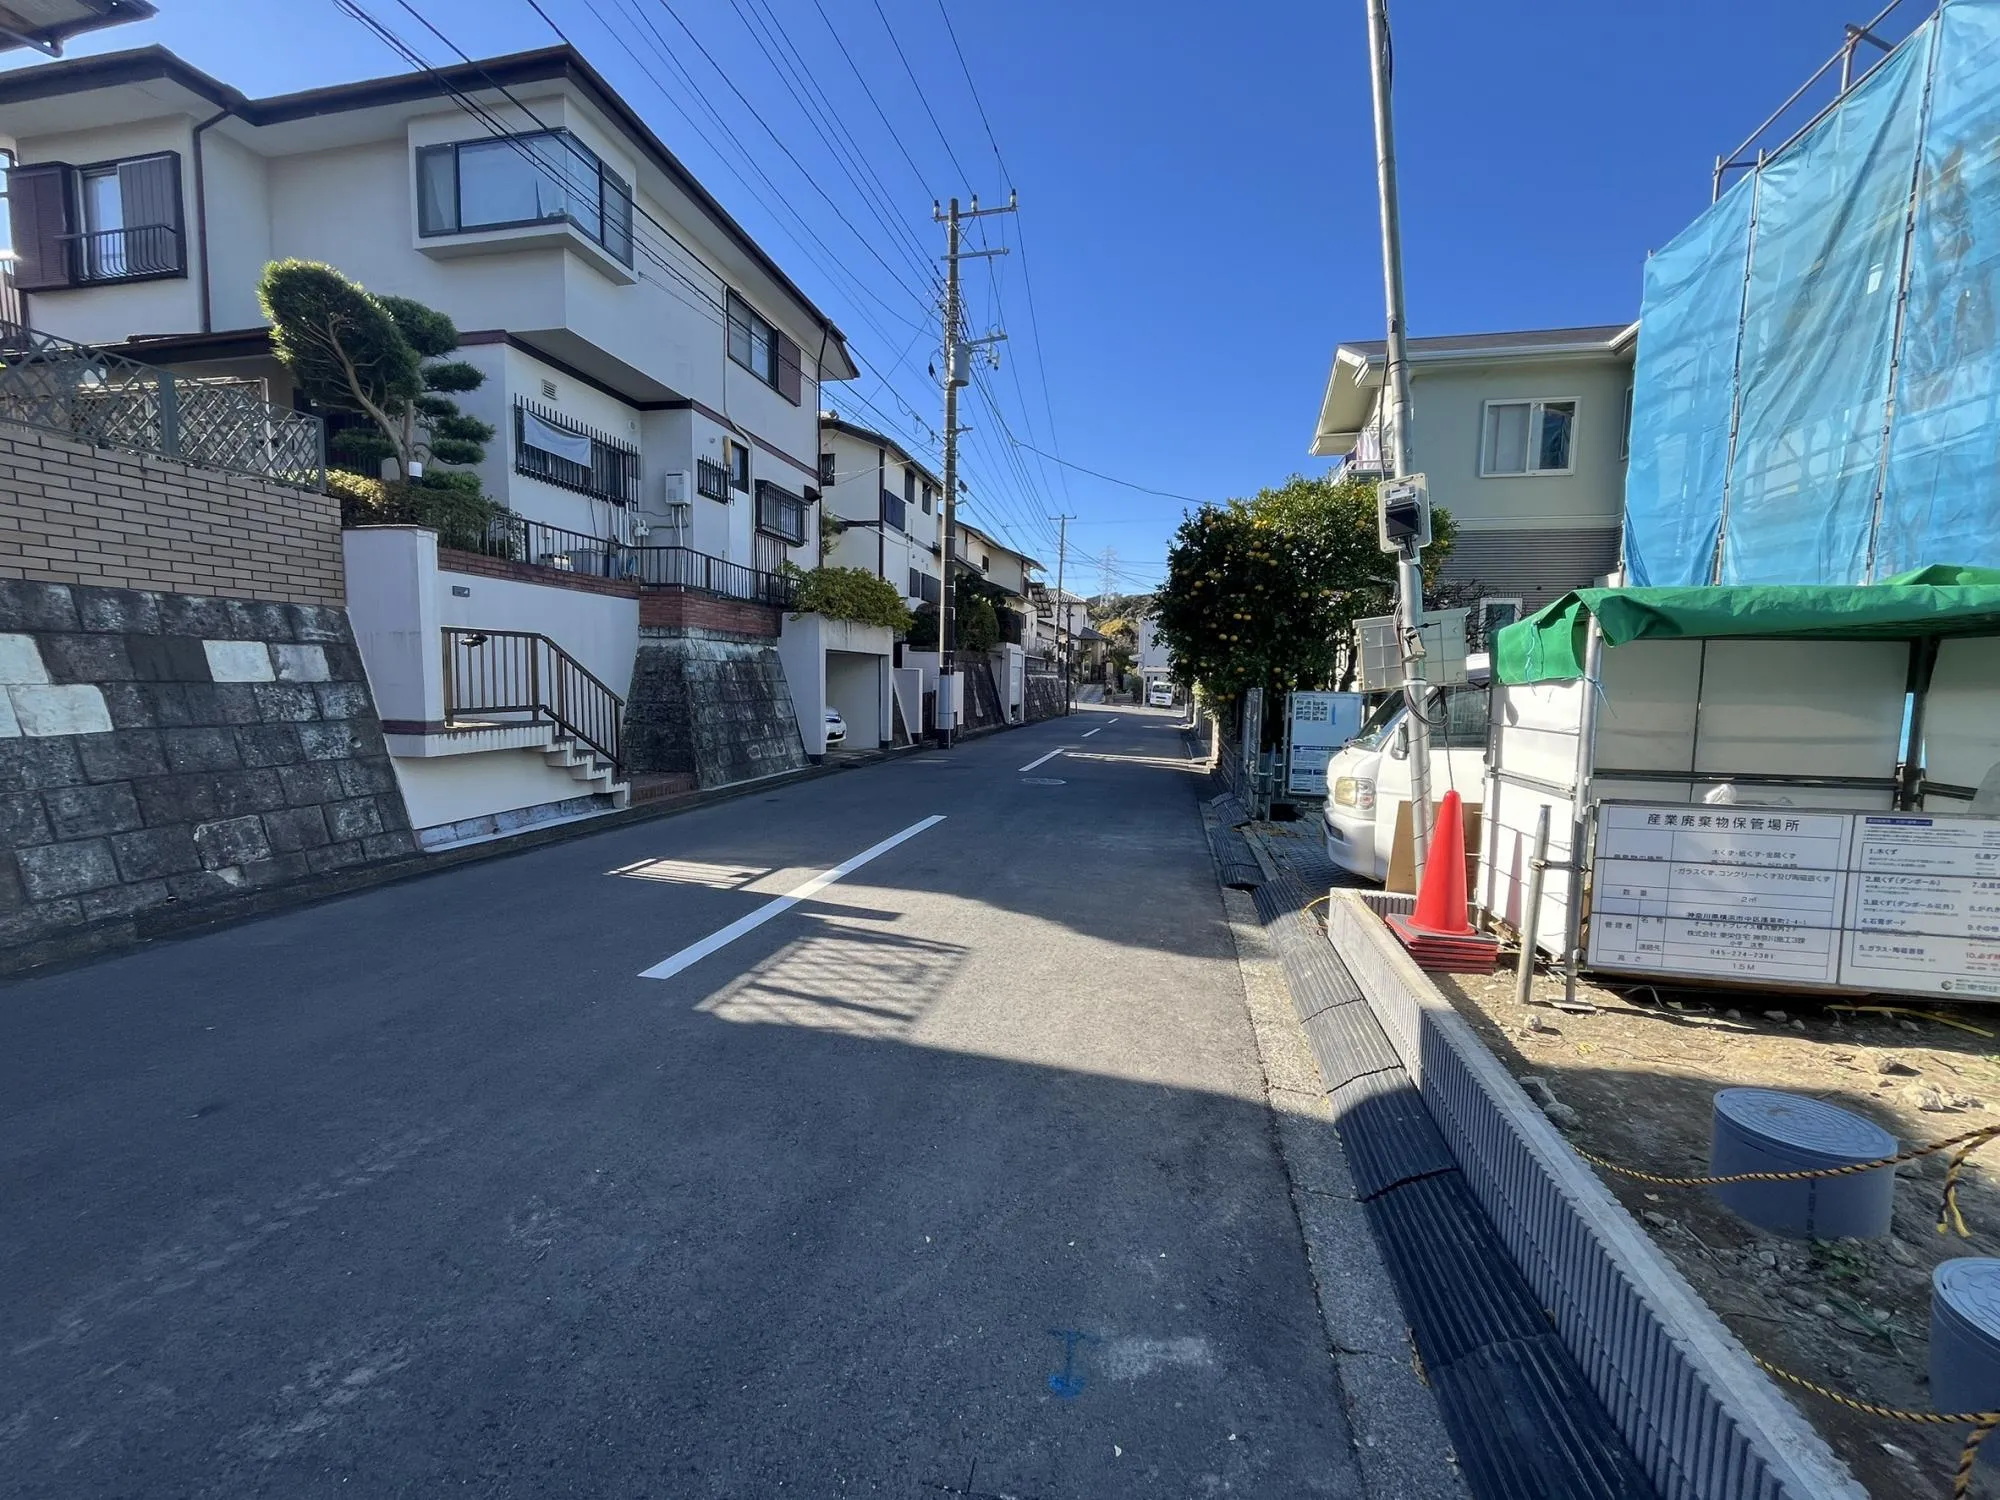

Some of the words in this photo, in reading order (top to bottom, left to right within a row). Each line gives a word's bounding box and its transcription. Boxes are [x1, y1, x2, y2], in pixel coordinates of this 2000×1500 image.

[1647, 813, 1800, 832] 産業廃棄物保管場所
